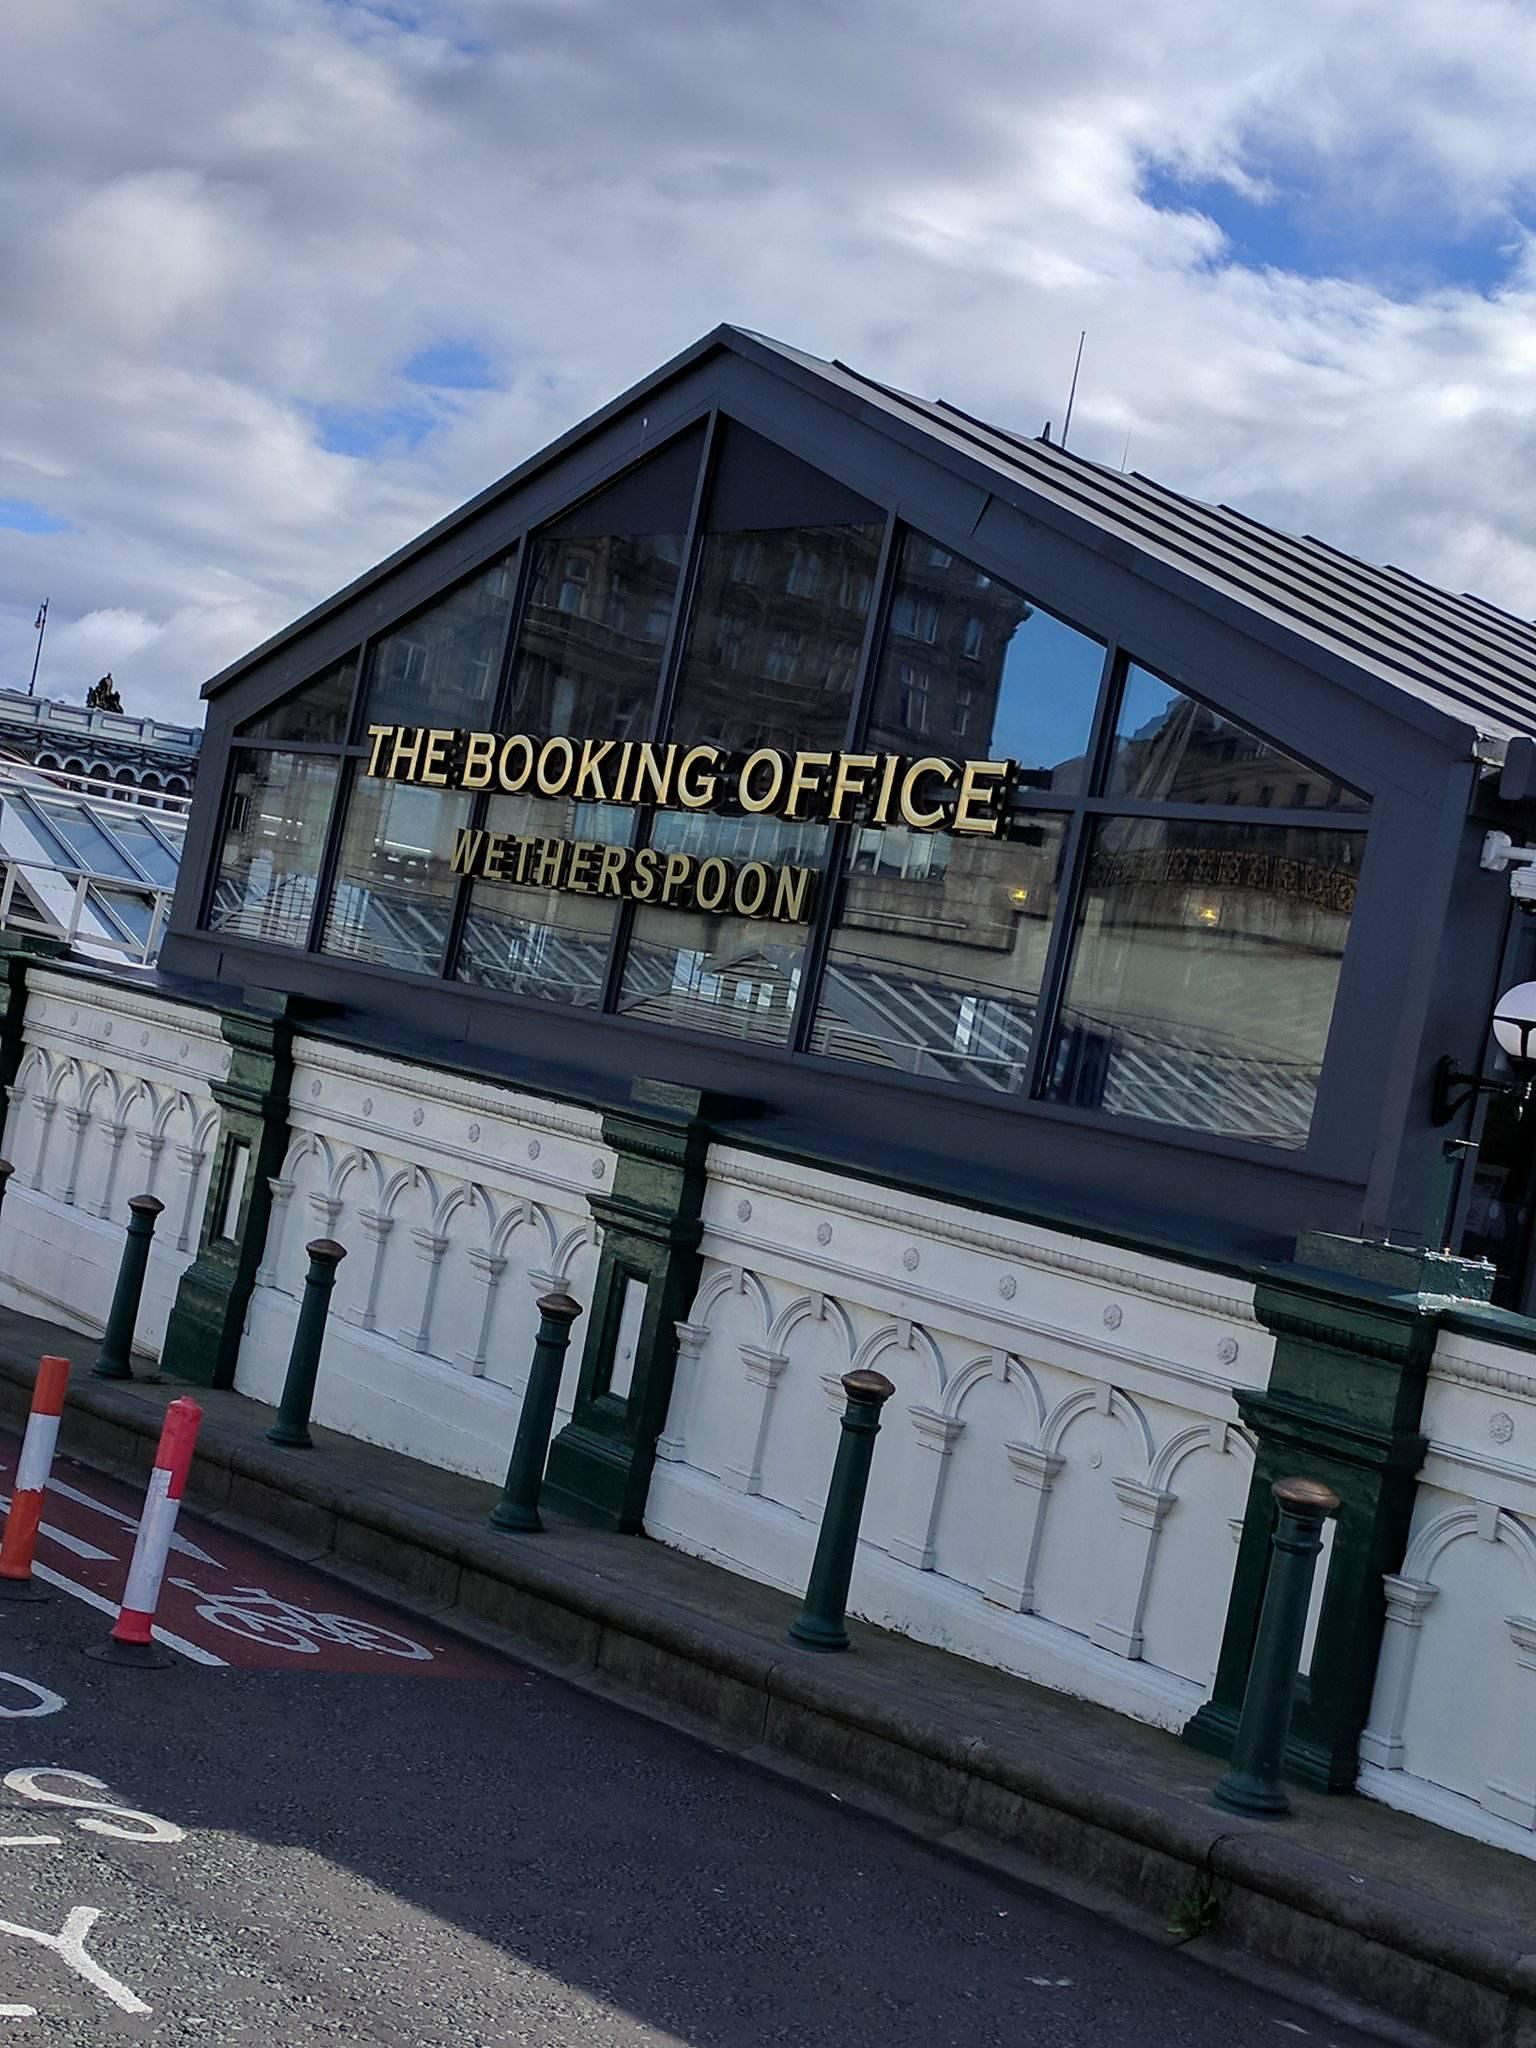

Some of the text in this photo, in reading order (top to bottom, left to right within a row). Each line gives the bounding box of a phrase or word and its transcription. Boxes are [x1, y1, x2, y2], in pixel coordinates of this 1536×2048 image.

[367, 724, 1008, 835] THE BOOKING OFFICE
[450, 828, 809, 921] WETHERSPOON
